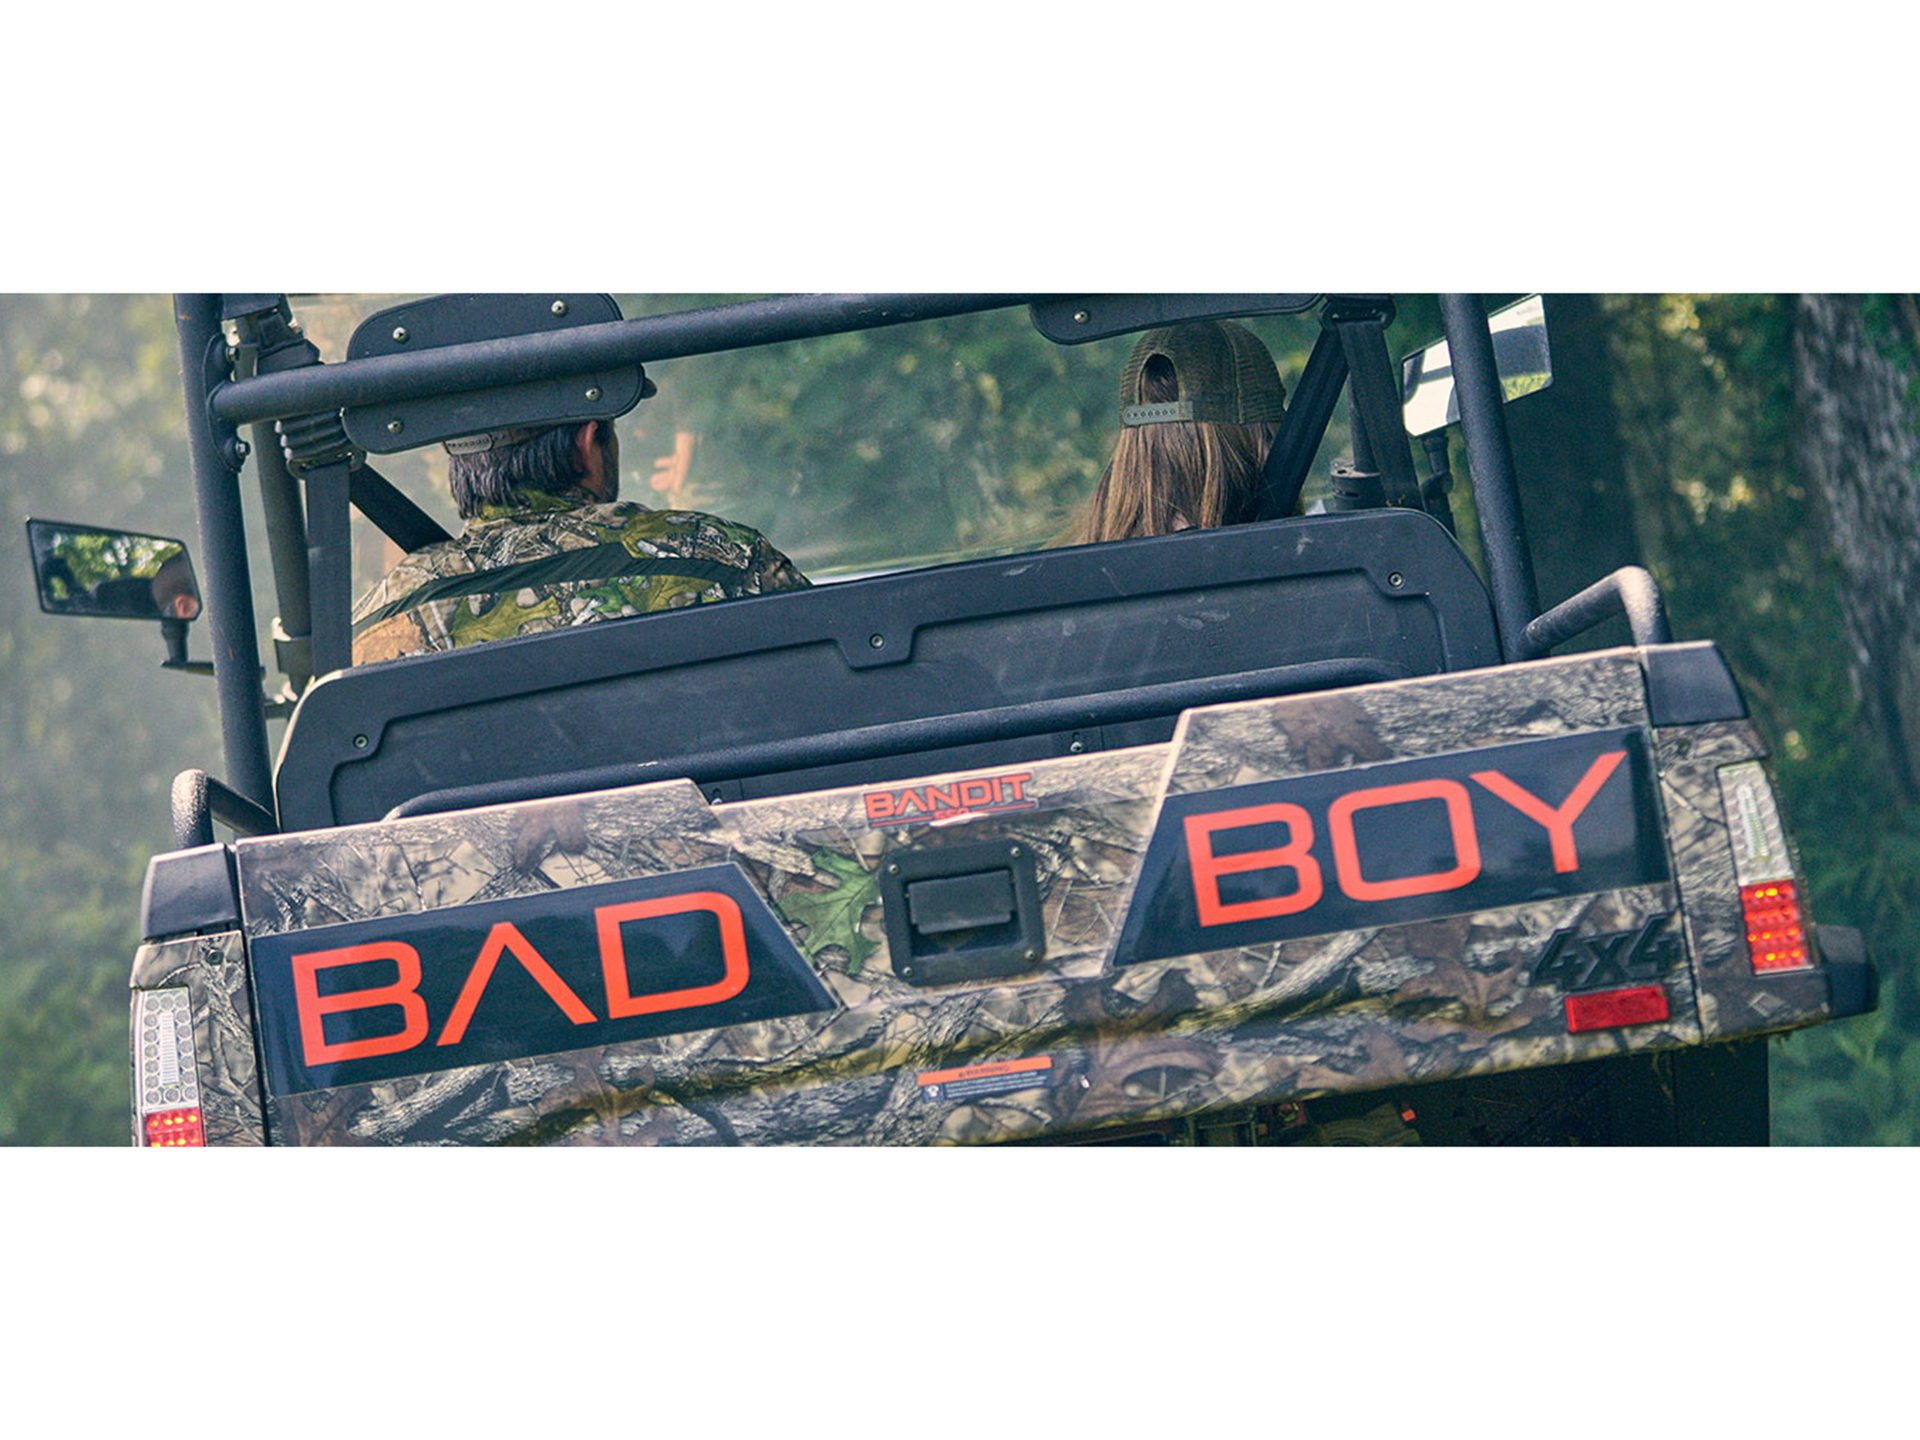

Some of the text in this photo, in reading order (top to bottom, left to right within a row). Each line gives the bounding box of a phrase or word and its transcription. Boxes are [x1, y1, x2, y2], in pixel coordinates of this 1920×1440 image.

[864, 773, 1032, 819] BANDIT
[1183, 751, 1626, 927] BOY
[291, 891, 750, 1067] BAD
